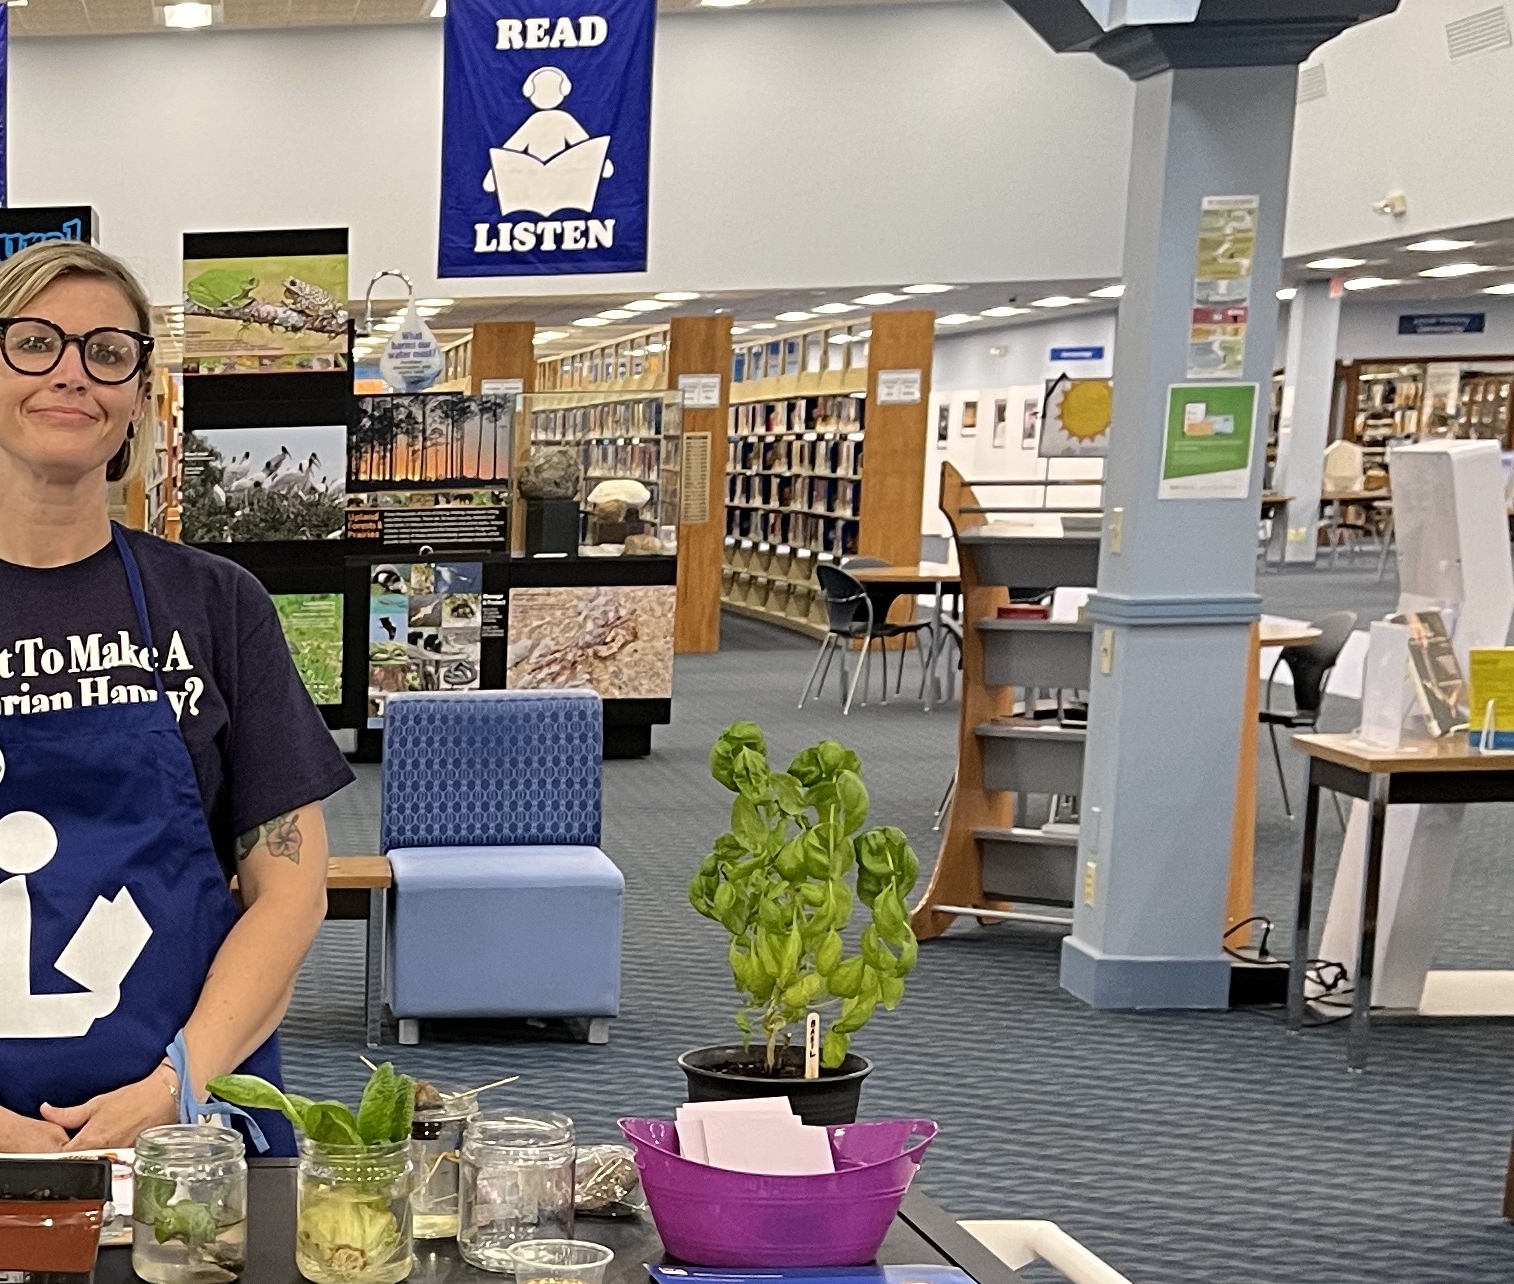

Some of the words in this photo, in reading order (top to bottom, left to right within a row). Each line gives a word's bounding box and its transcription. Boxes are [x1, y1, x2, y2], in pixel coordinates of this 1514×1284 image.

[495, 16, 608, 50] READ
[474, 219, 615, 253] LISTEN
[15, 637, 64, 677] To
[66, 630, 159, 673] Make
[161, 629, 194, 672] A
